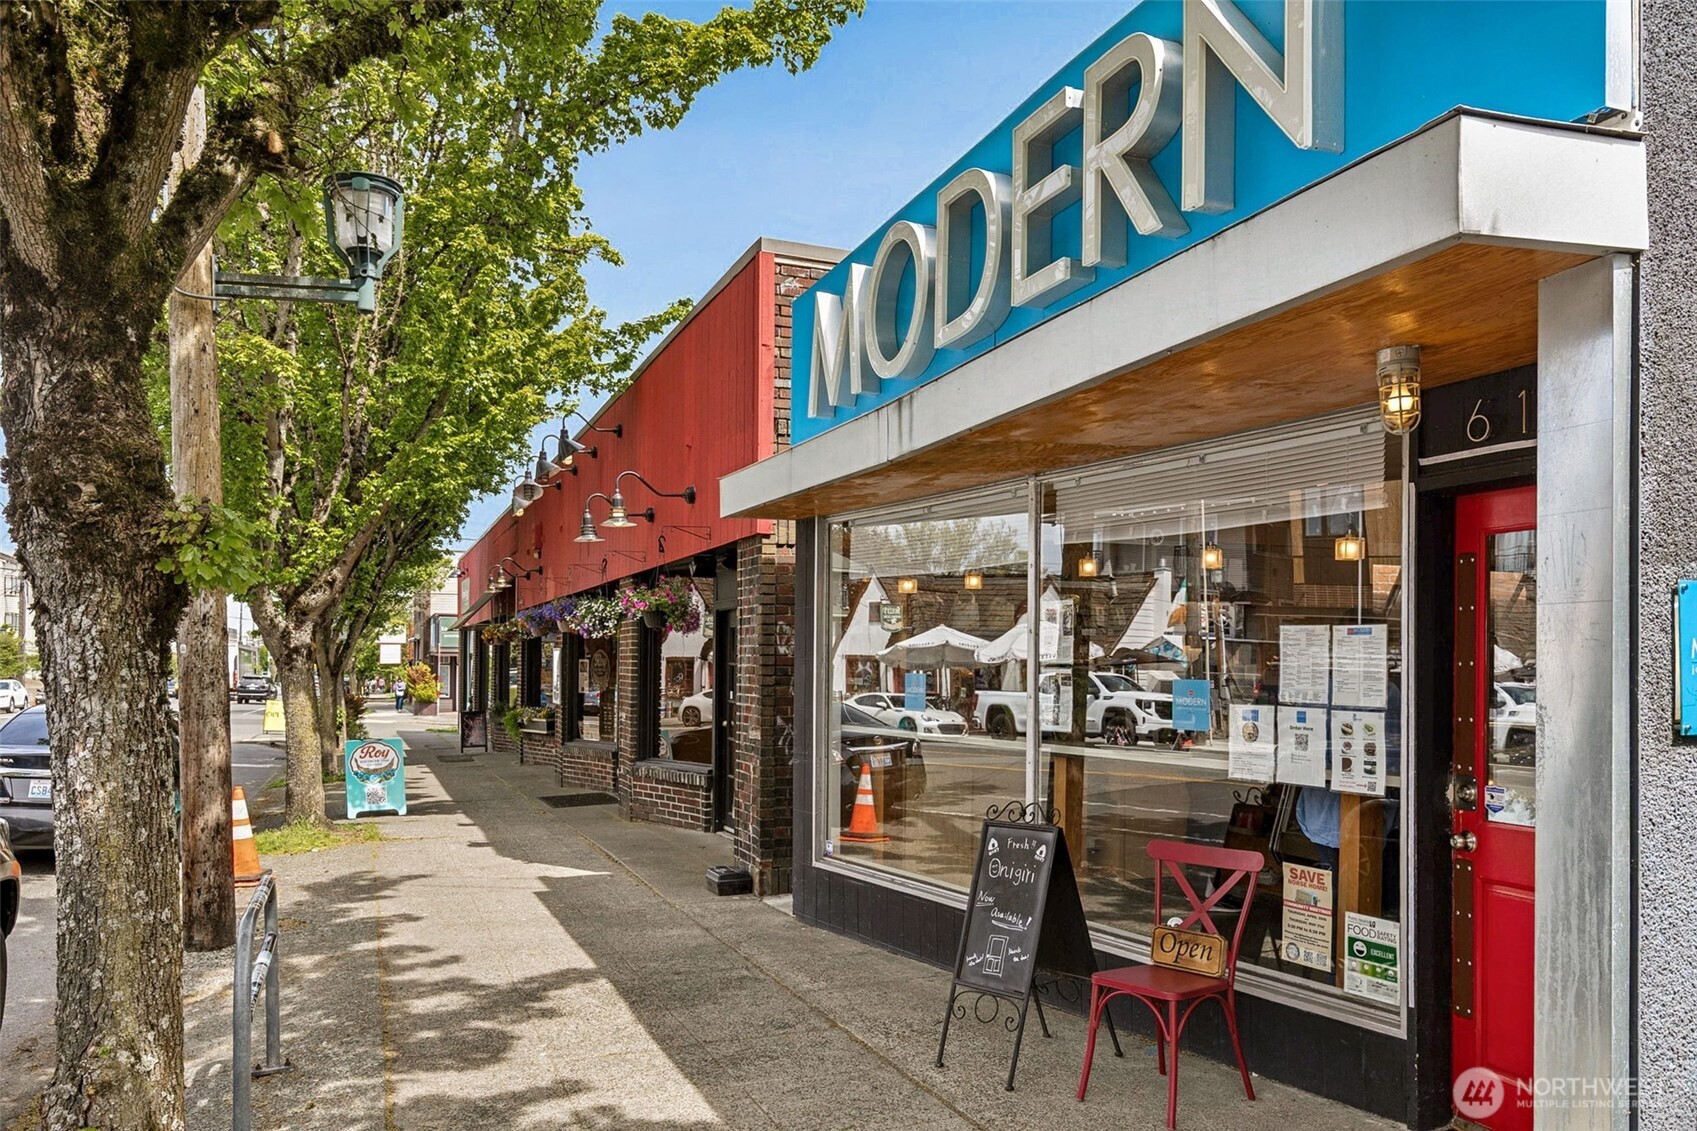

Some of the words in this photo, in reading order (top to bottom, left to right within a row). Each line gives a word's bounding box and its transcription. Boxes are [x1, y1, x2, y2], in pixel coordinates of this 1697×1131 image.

[808, 0, 1346, 418] MODERN
[1176, 697, 1207, 706] MODERN
[359, 745, 390, 759] Roy
[989, 858, 1035, 886] Onigiri
[1289, 867, 1325, 886] SAVE
[1347, 923, 1377, 939] FOOD
[1377, 930, 1397, 938] SAFETY
[1377, 935, 1397, 944] RATING
[1160, 932, 1213, 963] Open
[1370, 948, 1395, 960] EXCELLENT
